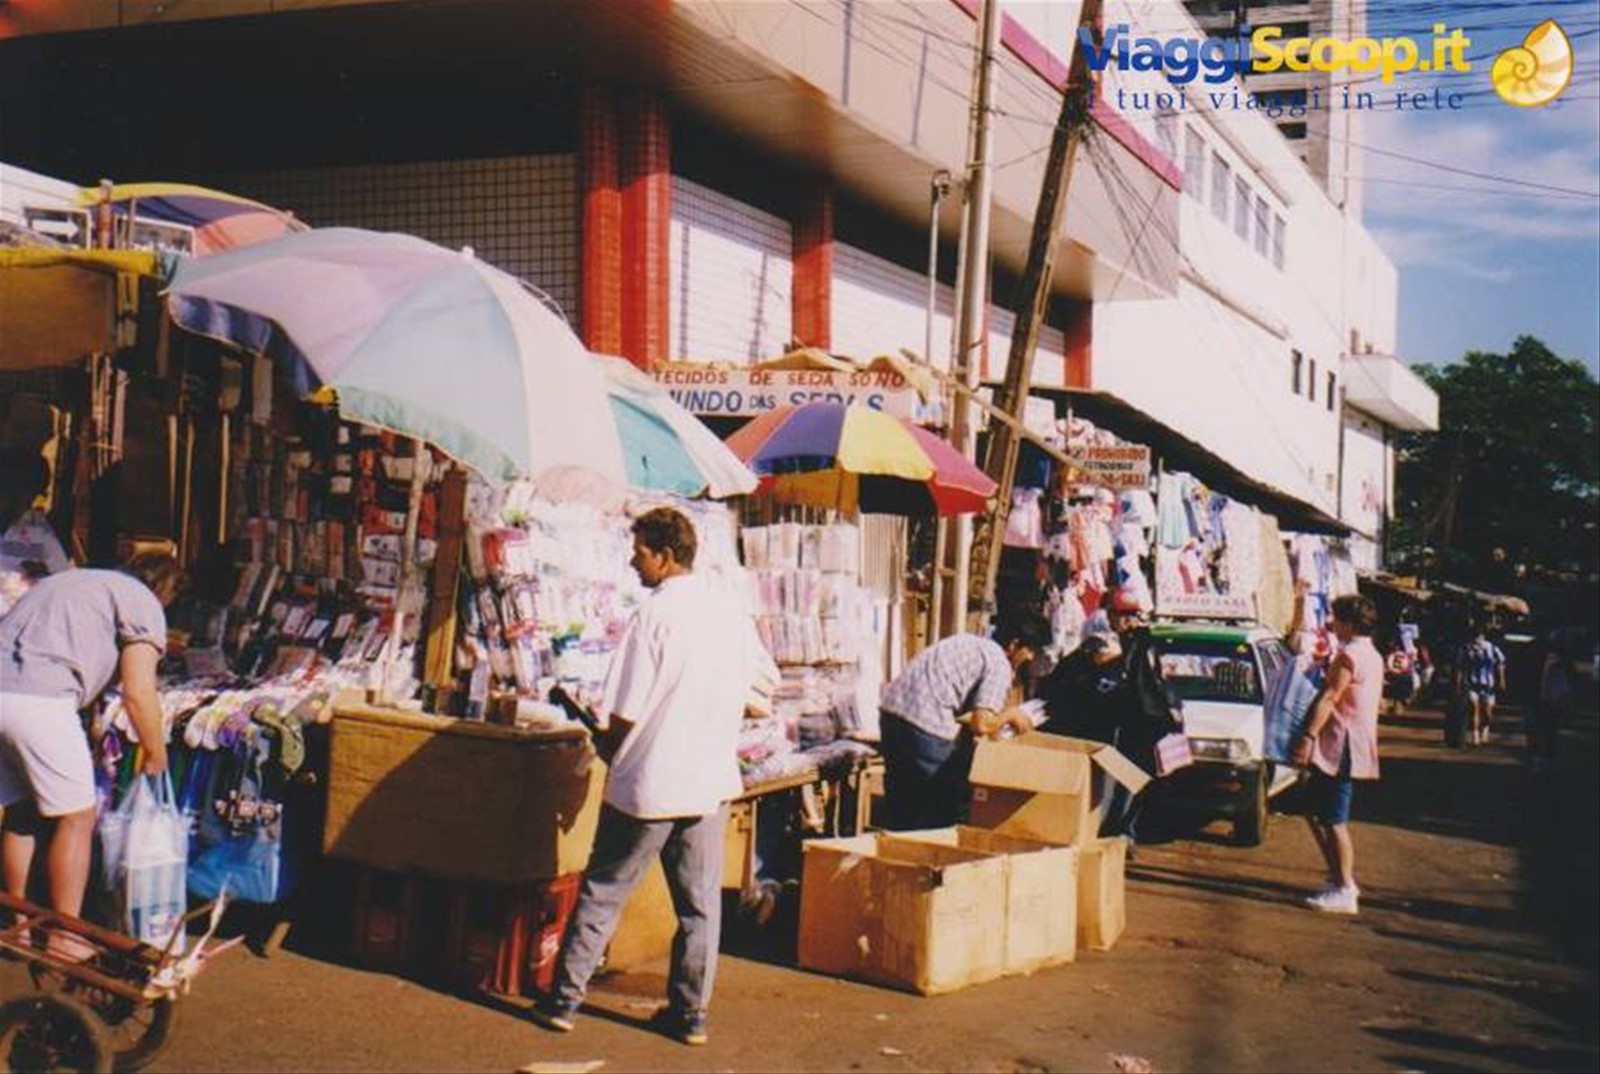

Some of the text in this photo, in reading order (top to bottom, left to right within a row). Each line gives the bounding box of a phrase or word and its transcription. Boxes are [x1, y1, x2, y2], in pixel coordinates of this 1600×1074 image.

[654, 369, 729, 385] TECIDOS
[749, 369, 774, 386] DE
[786, 371, 835, 386] SEDA
[749, 394, 776, 409] DAS
